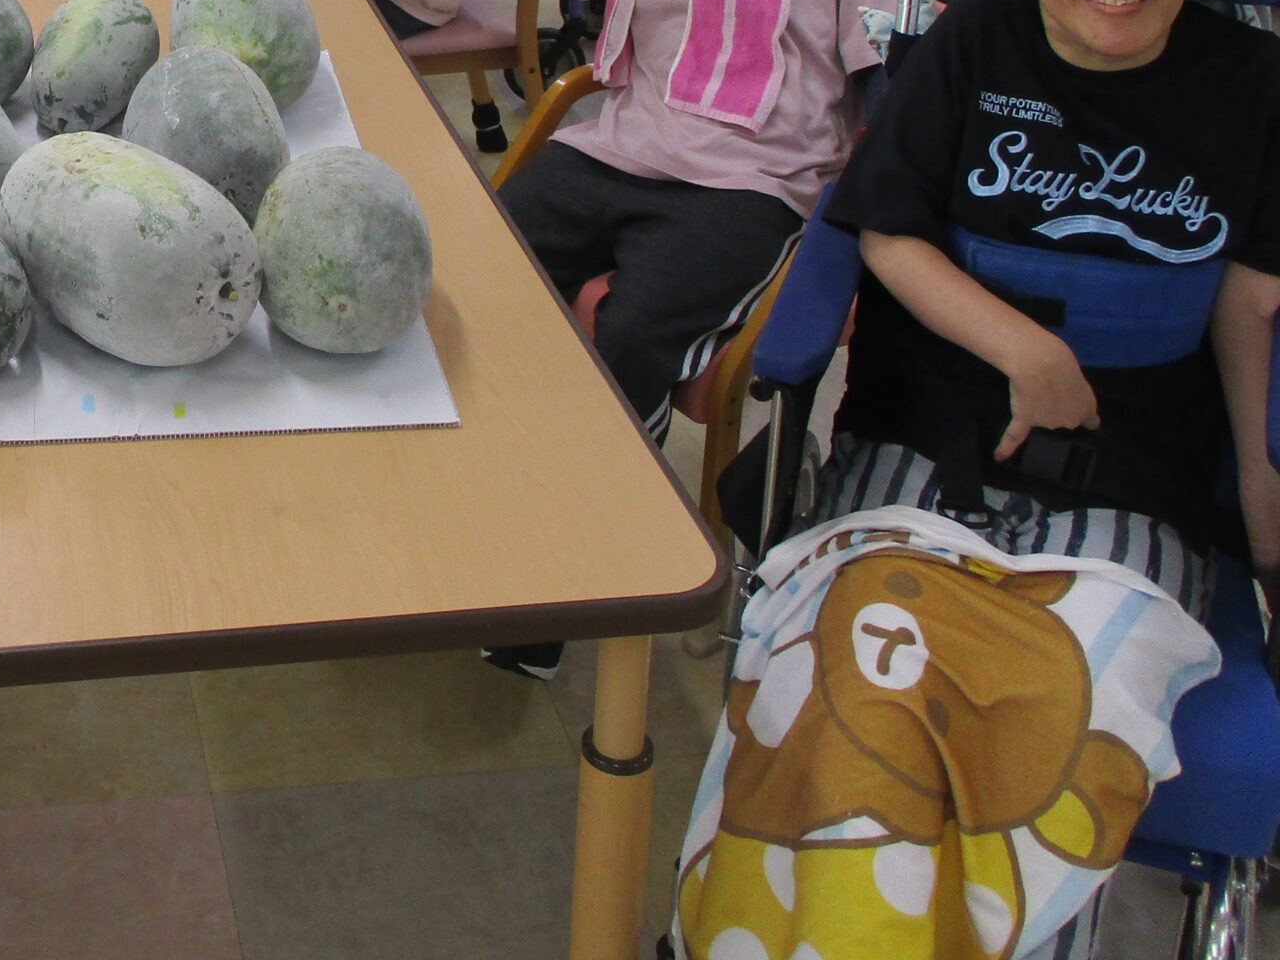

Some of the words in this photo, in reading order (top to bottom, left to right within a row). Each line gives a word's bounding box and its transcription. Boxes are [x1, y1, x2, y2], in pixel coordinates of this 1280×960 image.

[980, 90, 1008, 106] YOUR
[978, 100, 1010, 116] TRULY
[1011, 108, 1064, 128] LIMITLESS
[967, 130, 1077, 212] Stay
[1078, 143, 1212, 232] Lucky
